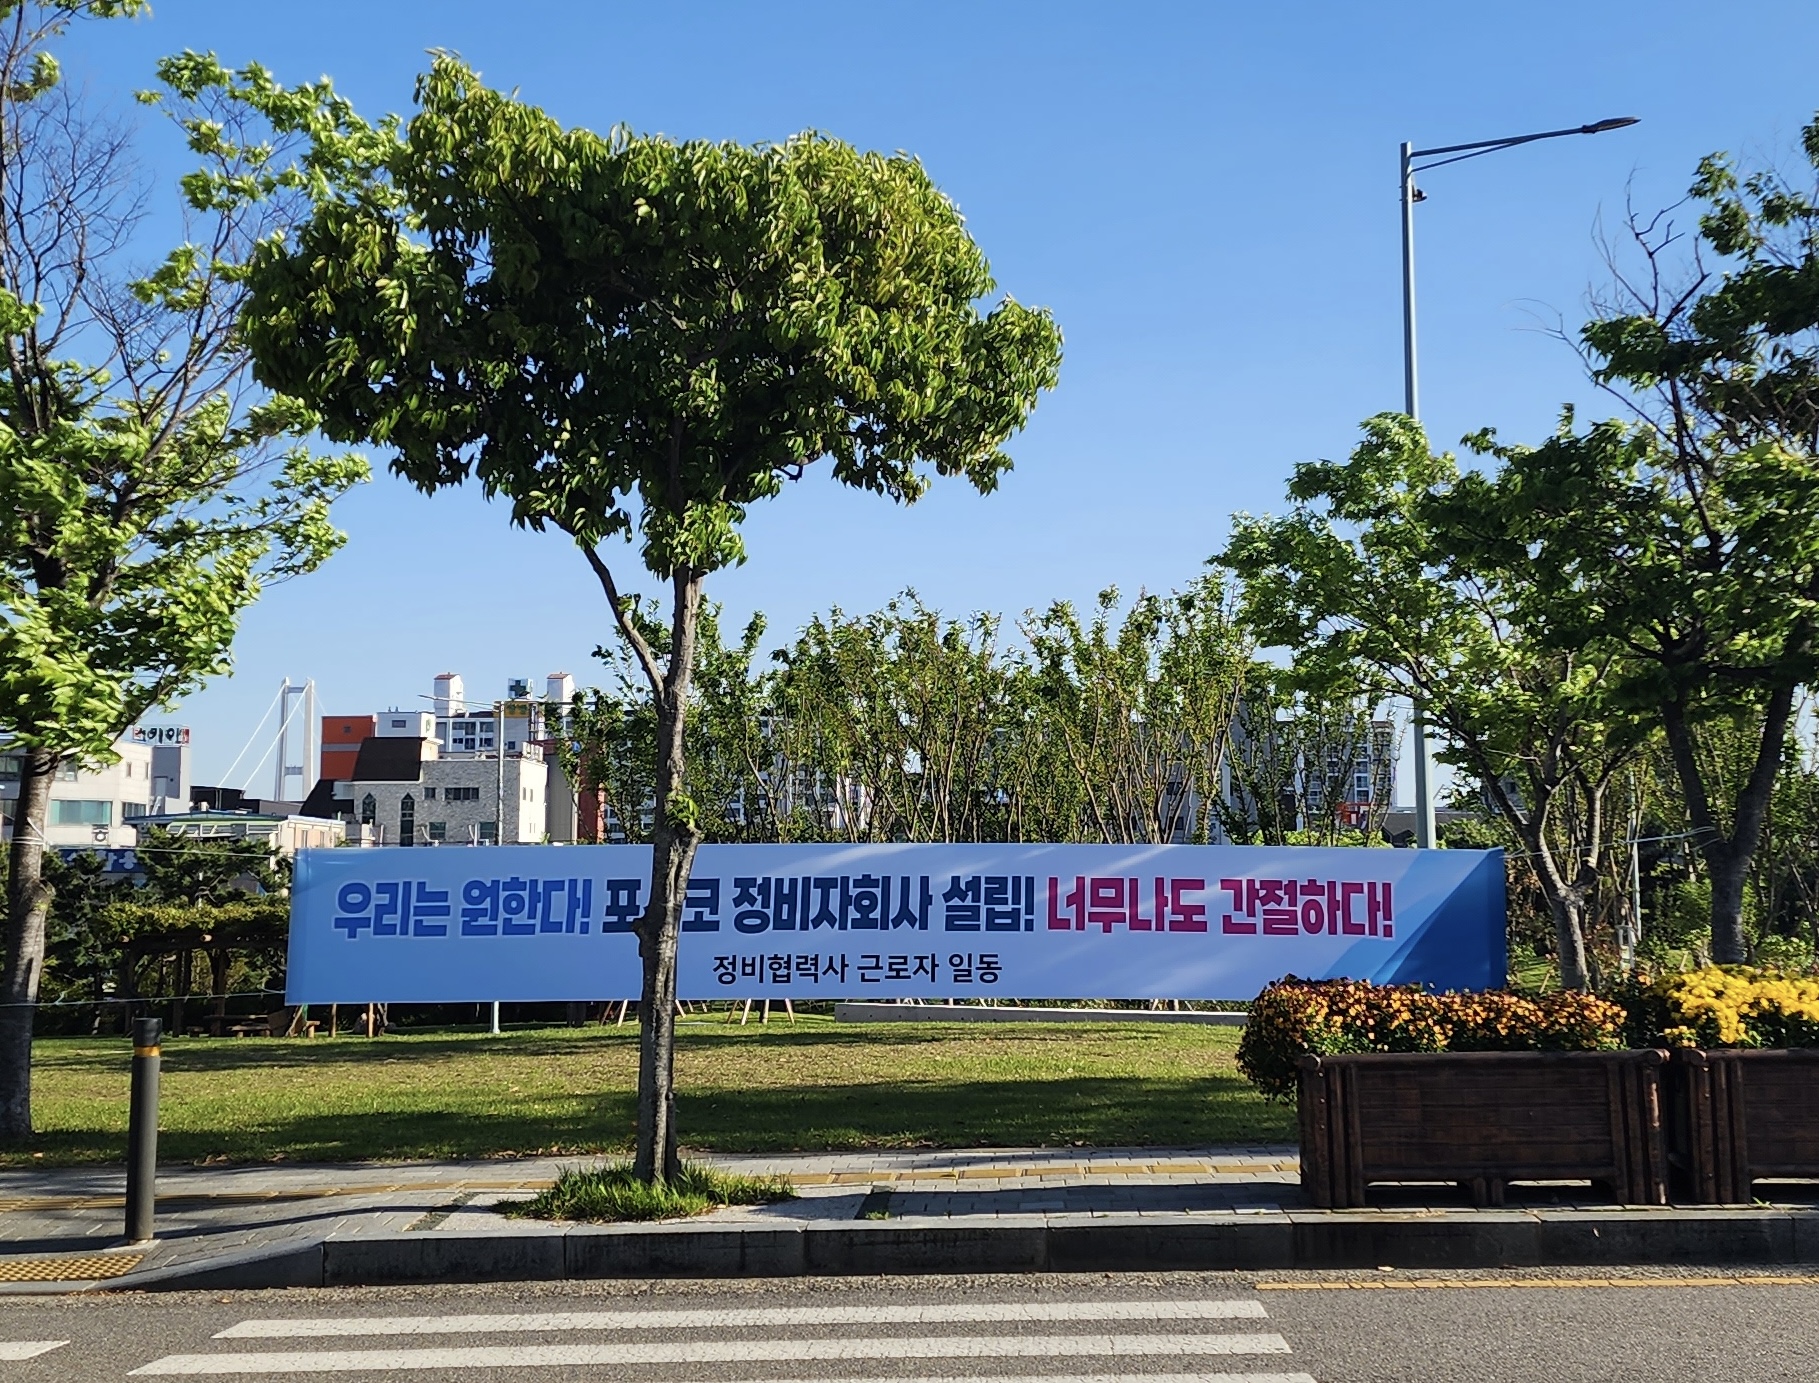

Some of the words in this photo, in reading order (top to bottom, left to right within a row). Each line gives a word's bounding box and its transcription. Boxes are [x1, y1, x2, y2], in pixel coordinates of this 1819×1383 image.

[334, 879, 451, 940] 우리는
[460, 876, 593, 937] 원한다!
[602, 877, 721, 933] 포코
[732, 874, 933, 934] 정비자회사
[942, 875, 1035, 932] 설립!
[1047, 876, 1208, 934] 너무나도
[1220, 878, 1393, 938] 간절하다!
[712, 953, 850, 985] 정비협력사
[856, 953, 940, 983] 근로자
[948, 952, 1003, 984] 일동
